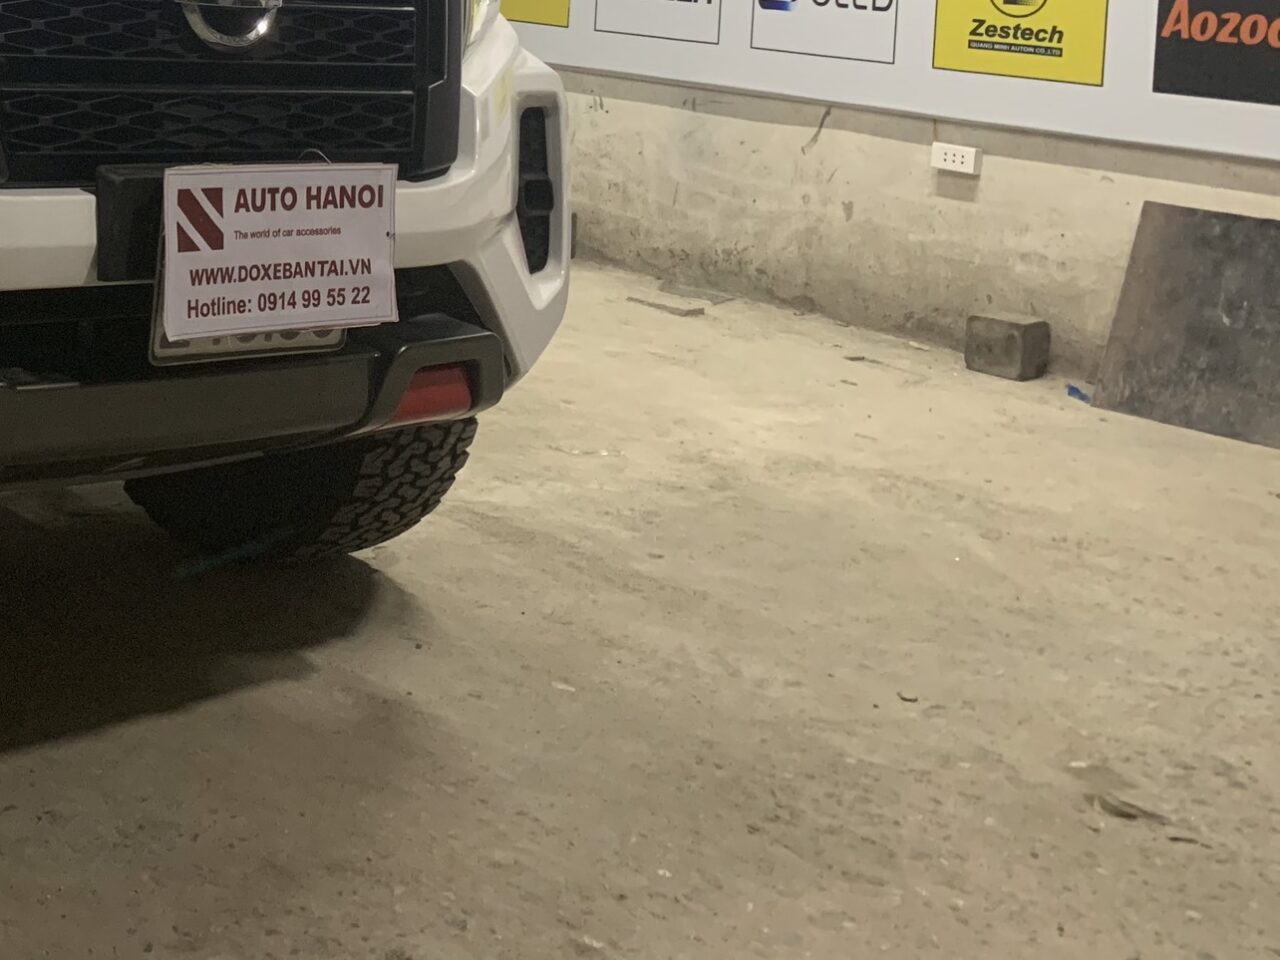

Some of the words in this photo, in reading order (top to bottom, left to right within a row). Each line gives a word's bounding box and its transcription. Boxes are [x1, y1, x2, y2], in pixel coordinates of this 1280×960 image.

[968, 18, 1064, 44] Zestech
[234, 187, 298, 213] AUTO
[306, 184, 384, 210] HANOI
[234, 230, 248, 240] The
[250, 228, 270, 239] world
[272, 228, 281, 238] of
[282, 229, 293, 237] car
[296, 226, 341, 236] accessories
[190, 258, 372, 286] WWW.DOXEBANTAI.VN
[187, 296, 252, 319] Hotline:
[258, 290, 297, 312] 0914
[301, 289, 320, 309] 99
[327, 288, 346, 306] 55
[351, 285, 370, 305] 22
